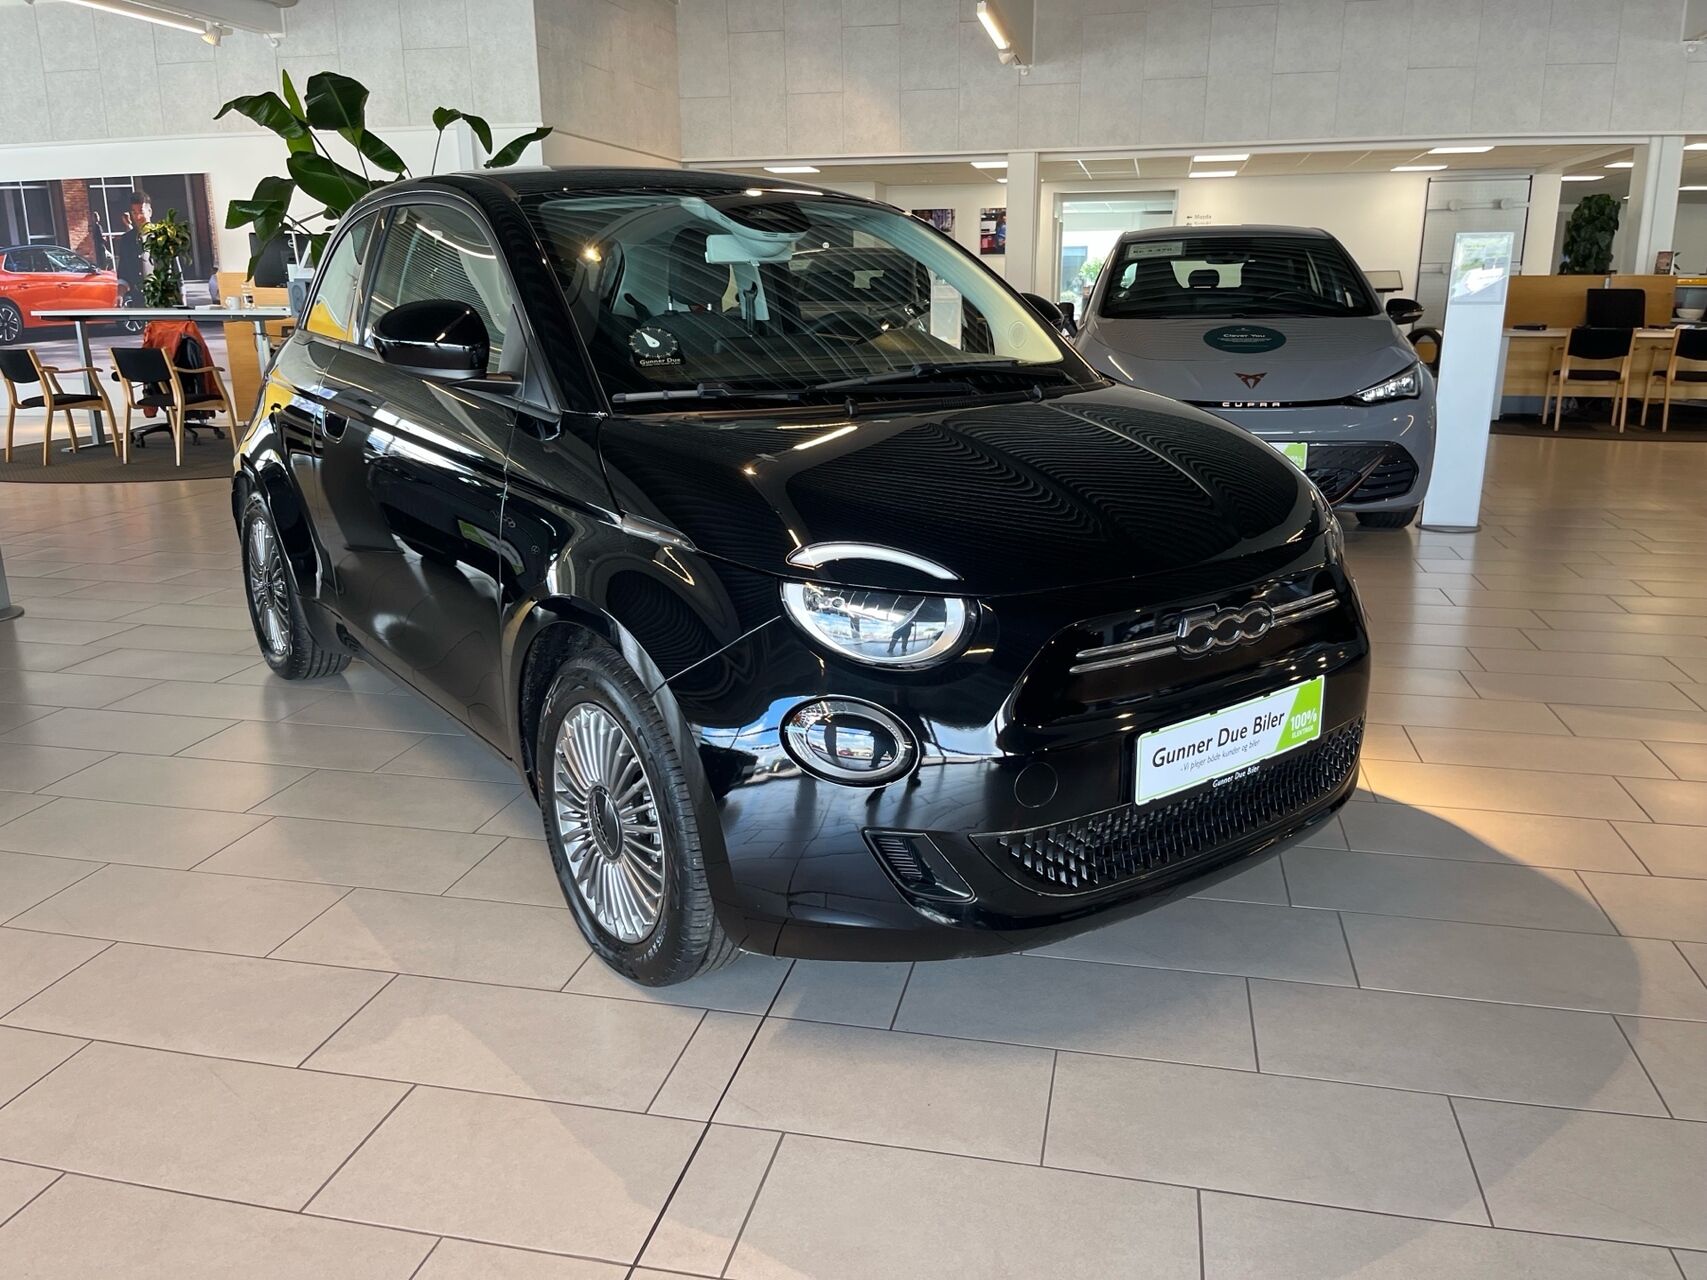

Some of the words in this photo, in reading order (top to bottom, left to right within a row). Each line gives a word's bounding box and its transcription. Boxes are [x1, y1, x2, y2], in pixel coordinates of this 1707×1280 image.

[1291, 708, 1317, 731] 100%
[1152, 737, 1213, 768] Gunner
[1217, 726, 1248, 747] Due
[1253, 712, 1285, 735] Biler
[1212, 775, 1234, 788] Gunner
[1234, 771, 1246, 780] Due
[1247, 765, 1260, 775] Biler
